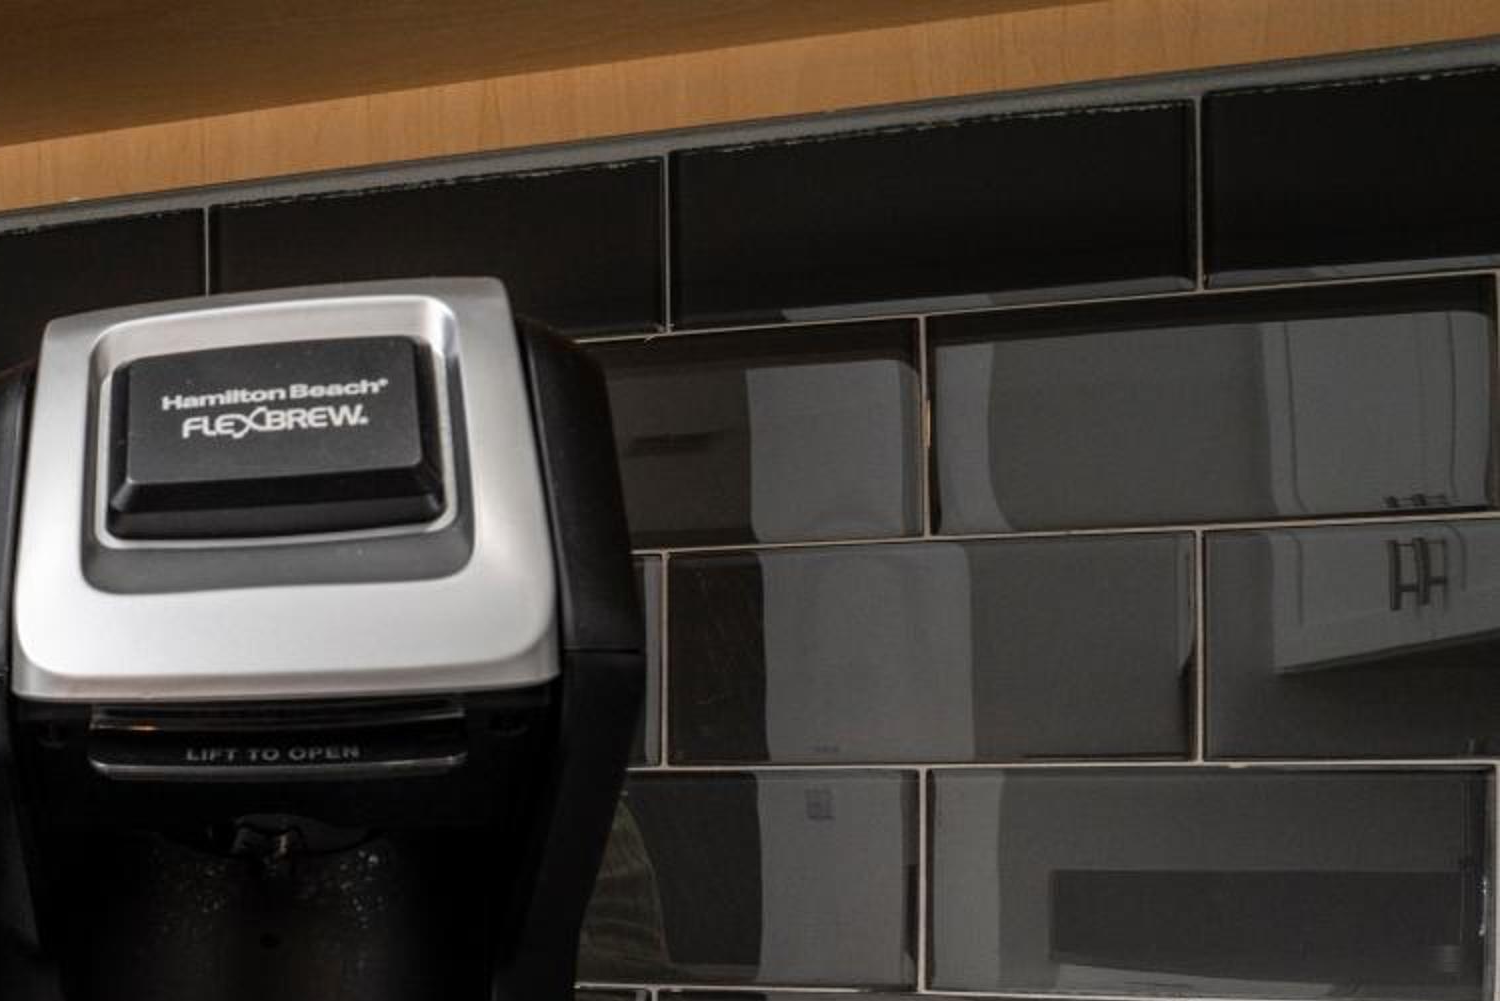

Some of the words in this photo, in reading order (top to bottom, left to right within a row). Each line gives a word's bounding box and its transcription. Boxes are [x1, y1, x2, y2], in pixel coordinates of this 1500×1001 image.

[161, 387, 287, 411] Hamilton
[185, 747, 238, 761] LIFT
[249, 747, 281, 761] TO
[287, 745, 361, 761] OPEN
